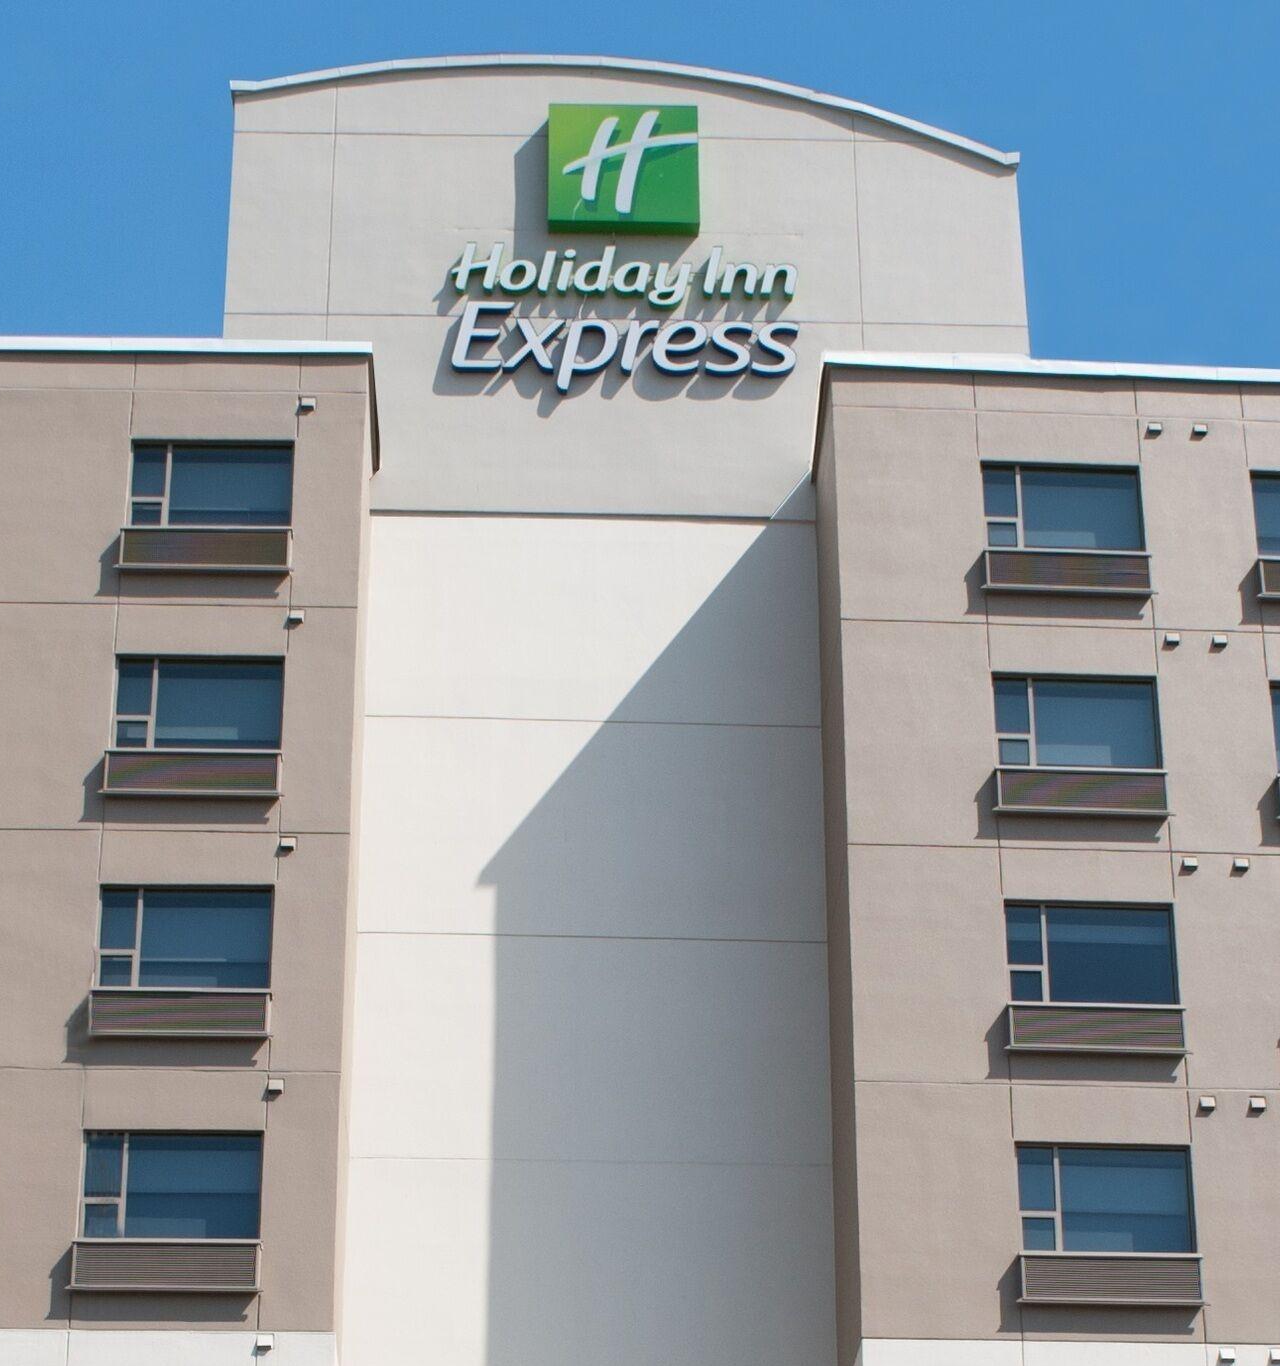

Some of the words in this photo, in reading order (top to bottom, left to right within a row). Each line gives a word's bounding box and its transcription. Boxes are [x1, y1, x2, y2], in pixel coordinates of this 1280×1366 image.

[450, 241, 693, 310] Holiday
[703, 246, 799, 299] Inn
[451, 301, 799, 395] Express
